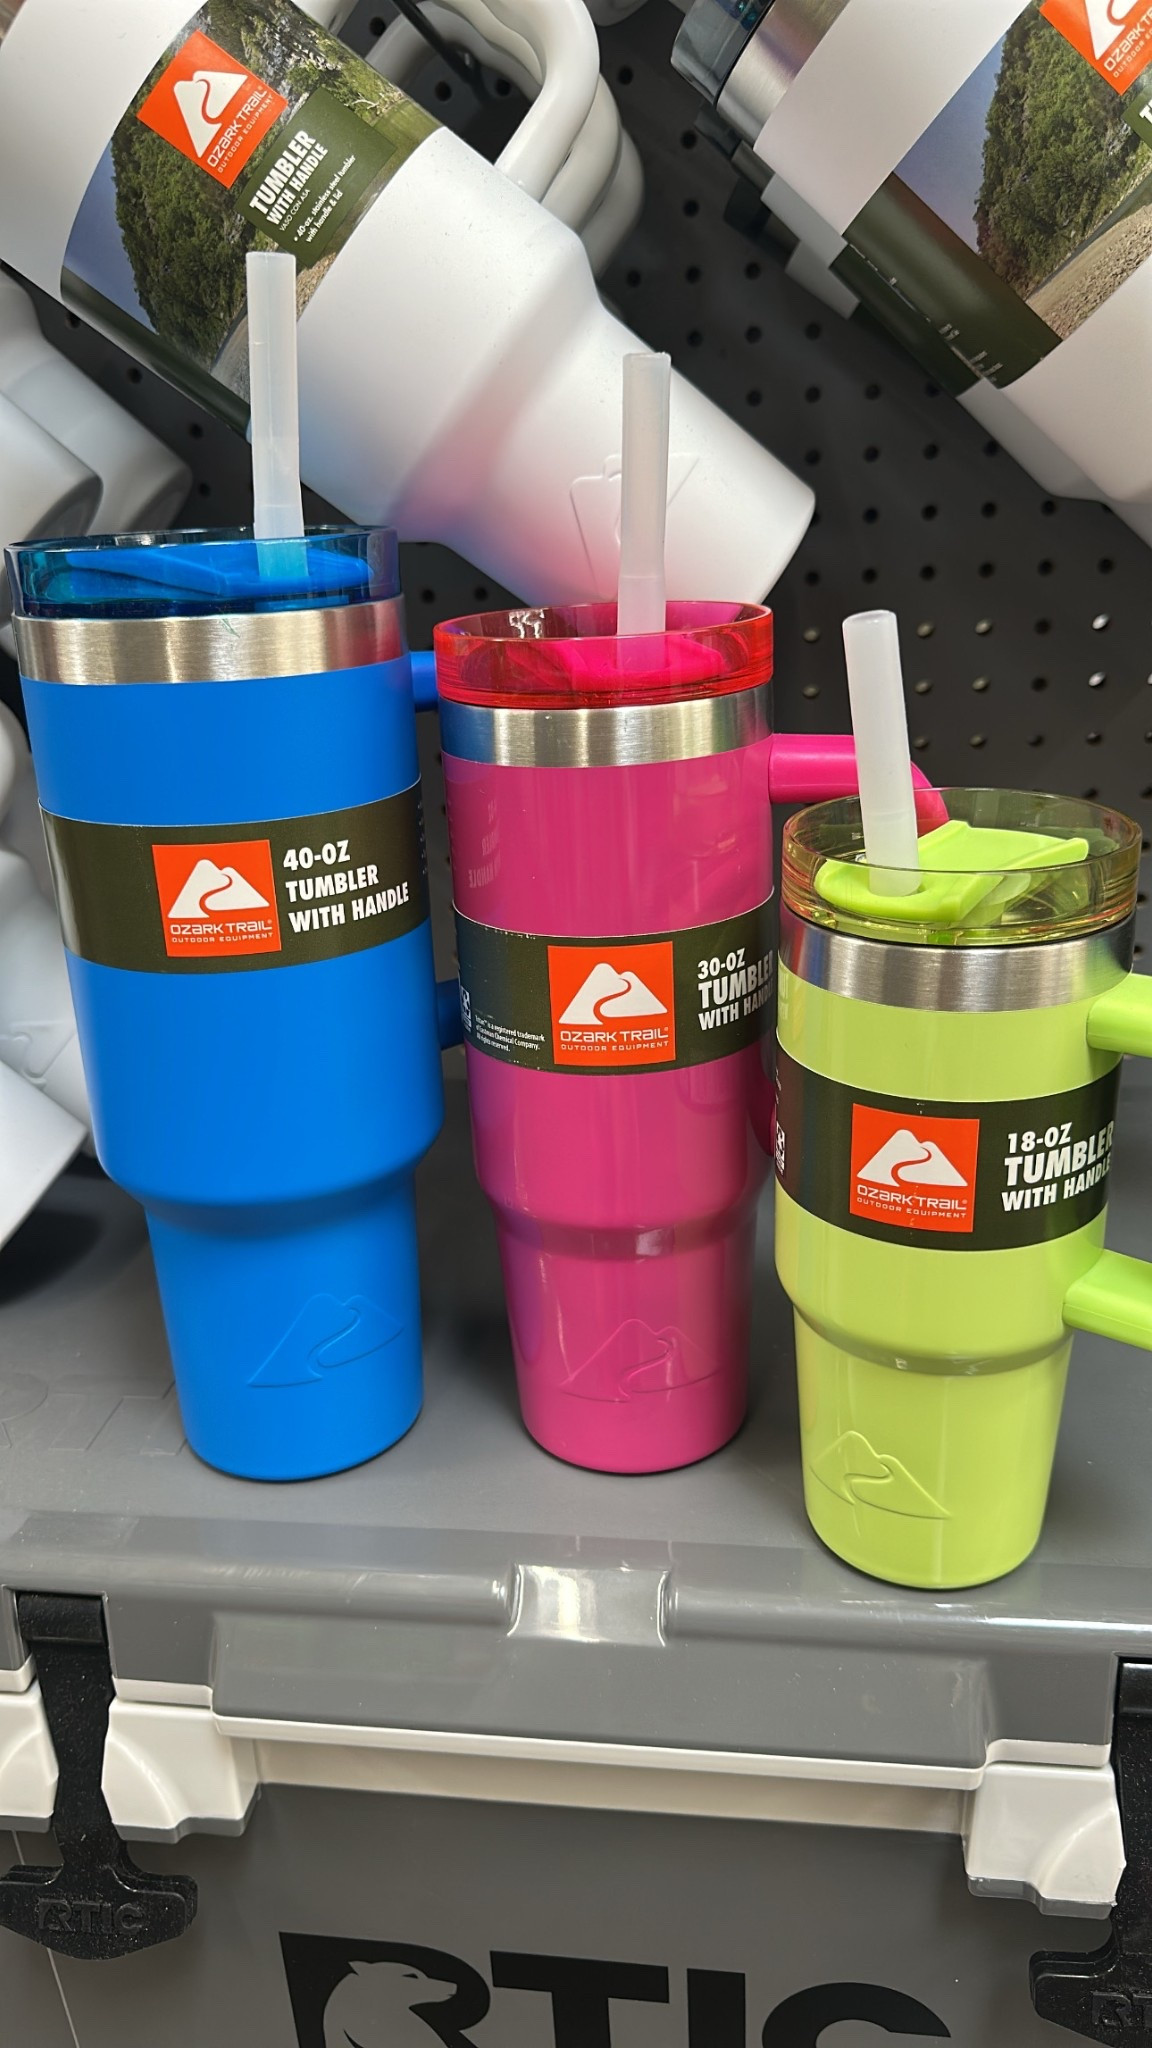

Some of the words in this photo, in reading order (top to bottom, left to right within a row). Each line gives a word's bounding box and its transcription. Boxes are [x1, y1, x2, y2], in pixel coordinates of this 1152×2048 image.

[207, 119, 243, 167] OZARK
[217, 135, 243, 173] OUTDOOR
[242, 94, 273, 135] EQUIPMENT
[249, 130, 316, 215] TUMBLER
[266, 188, 296, 225] WITH
[289, 142, 328, 192] HANDLE
[311, 189, 331, 216] stainless
[329, 173, 341, 191] steel
[338, 154, 356, 177] tumbler
[279, 215, 293, 231] VASO
[290, 201, 302, 215] CON
[300, 188, 311, 202] ASA
[306, 227, 318, 243] with
[314, 205, 332, 229] handle
[332, 189, 343, 201] lid
[283, 839, 351, 871] 40-OZ
[285, 864, 379, 903] TUMBLER
[288, 903, 346, 933] WITH
[351, 881, 410, 921] HANDLE
[170, 923, 224, 935] OZARK
[219, 932, 273, 942] EQUIPMENT
[697, 947, 746, 980] 30-OZ
[698, 1001, 739, 1031] WITH
[494, 1025, 516, 1037] registered
[517, 1030, 545, 1042] trademark
[495, 1033, 514, 1044] Chemical
[514, 1038, 541, 1051] Company.
[560, 1030, 618, 1043] OZARK
[612, 1040, 669, 1051] EQUIPMENT
[1004, 1120, 1114, 1186] TUMBLER
[1008, 1122, 1073, 1154] 18-OZ
[857, 1184, 913, 1206] OZARK
[1001, 1182, 1058, 1212] WITH
[1063, 1151, 1111, 1200] HANDLE
[856, 1197, 902, 1212] OUTDOOR
[906, 1208, 967, 1218] EQUIPMENT
[38, 1898, 145, 1934] RTIC
